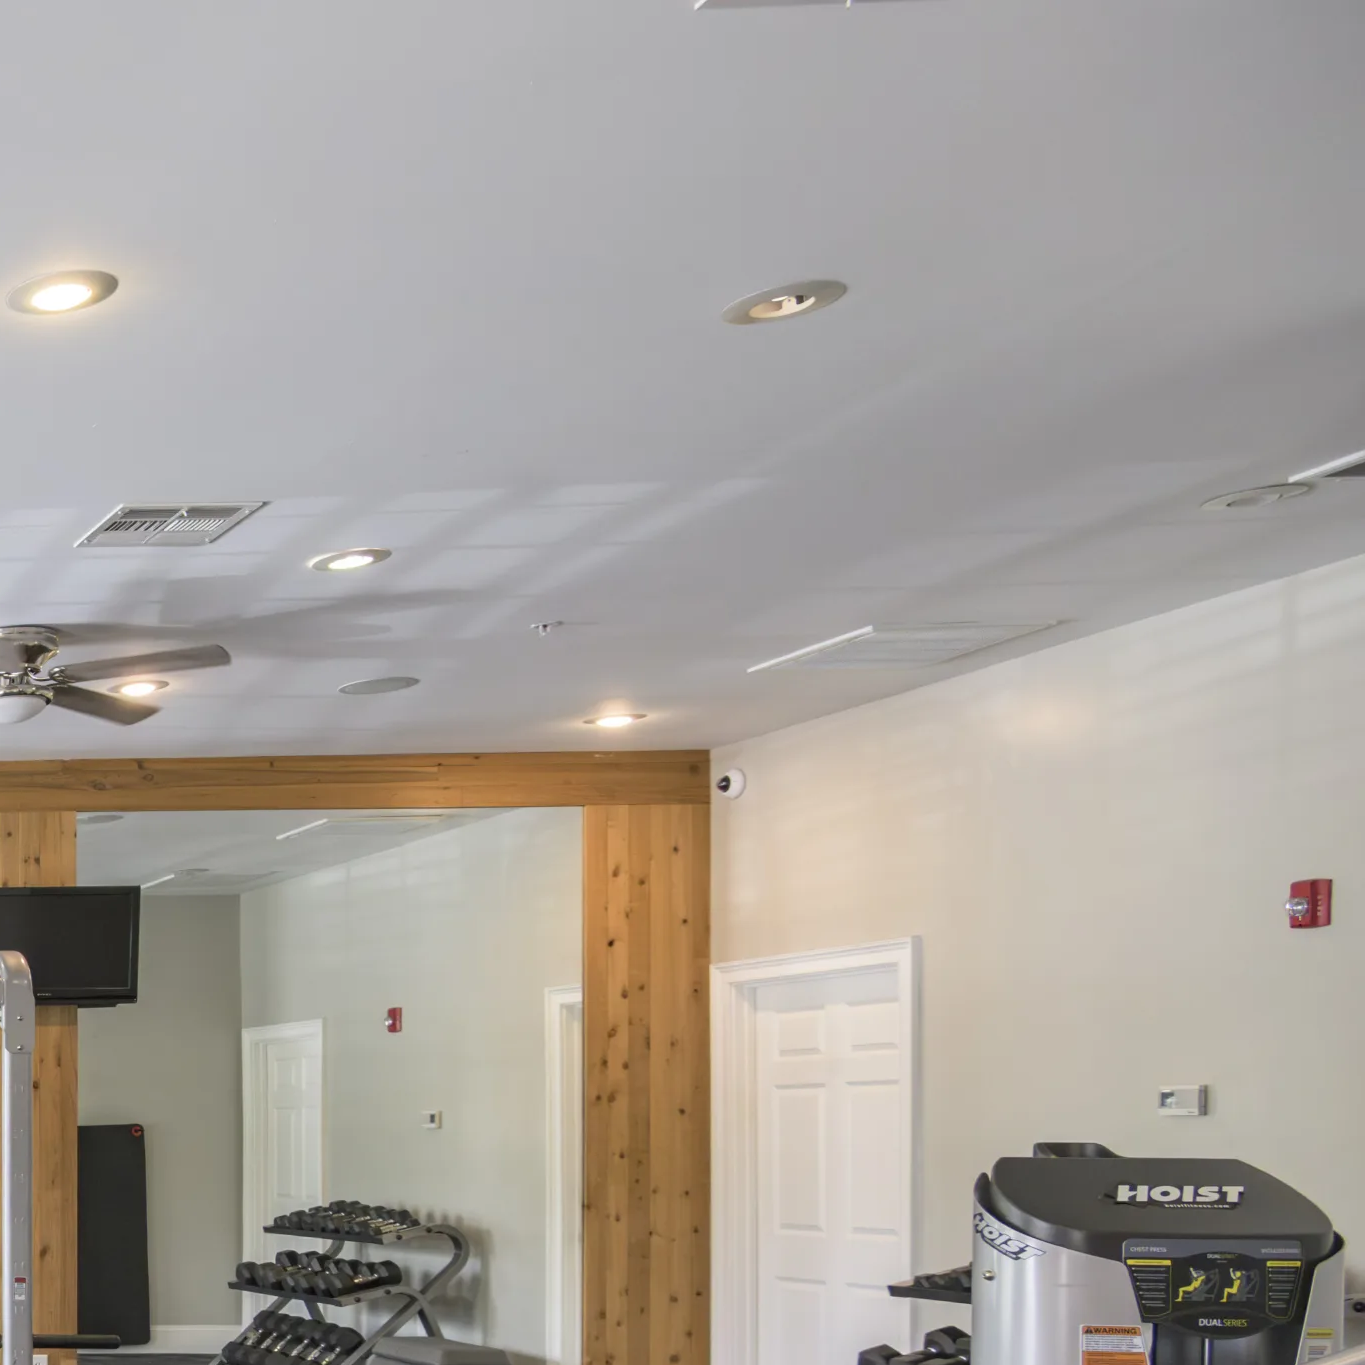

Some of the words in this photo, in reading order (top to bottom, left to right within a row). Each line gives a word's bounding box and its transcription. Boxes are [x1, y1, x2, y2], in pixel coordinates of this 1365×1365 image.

[1116, 1184, 1245, 1203] HOIST
[973, 1212, 1047, 1260] HOIST
[1092, 1327, 1138, 1335] WARNING
